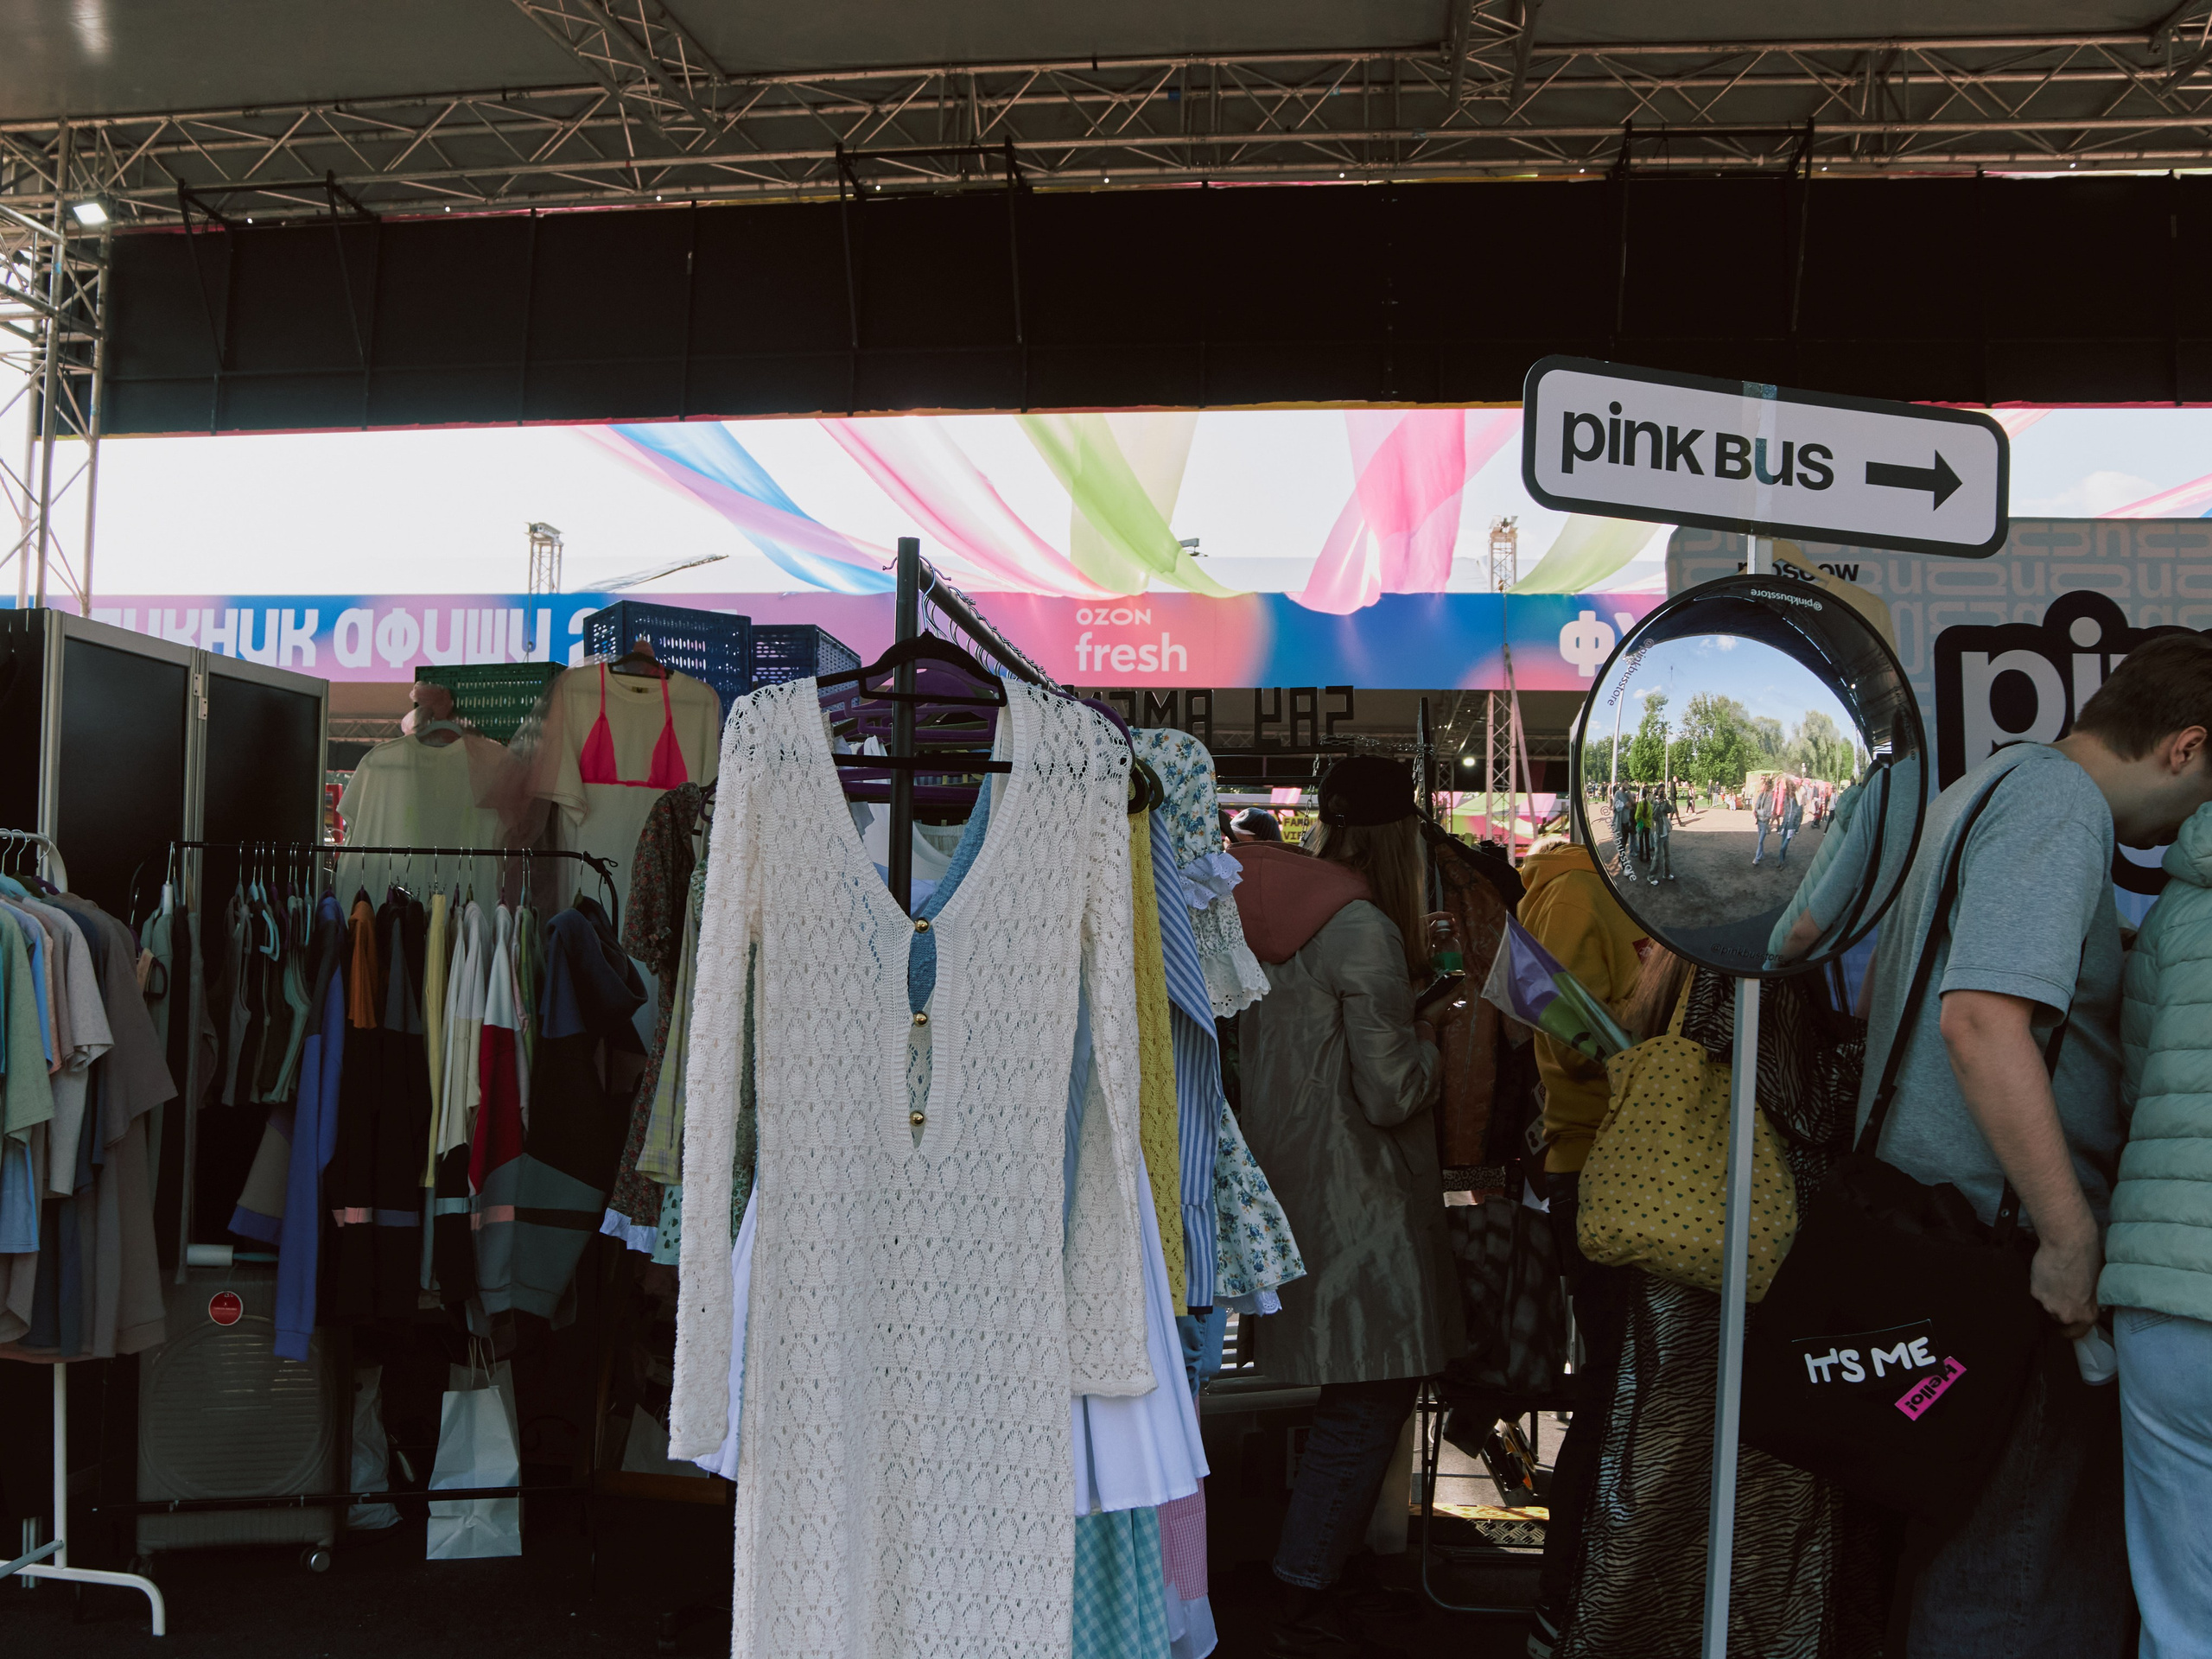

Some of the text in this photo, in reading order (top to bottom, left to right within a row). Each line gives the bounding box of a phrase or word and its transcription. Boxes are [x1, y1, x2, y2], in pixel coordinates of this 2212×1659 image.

[1076, 607, 1151, 626] OZON
[1751, 588, 1822, 611] @pinkbusstore
[1075, 632, 1187, 672] fresh
[1607, 638, 1655, 706] @pinkbusstore
[1711, 944, 1783, 962] @pinkbusstore
[1804, 1337, 1936, 1383] IT'S ME
[1904, 1363, 1958, 1412] Hello!
